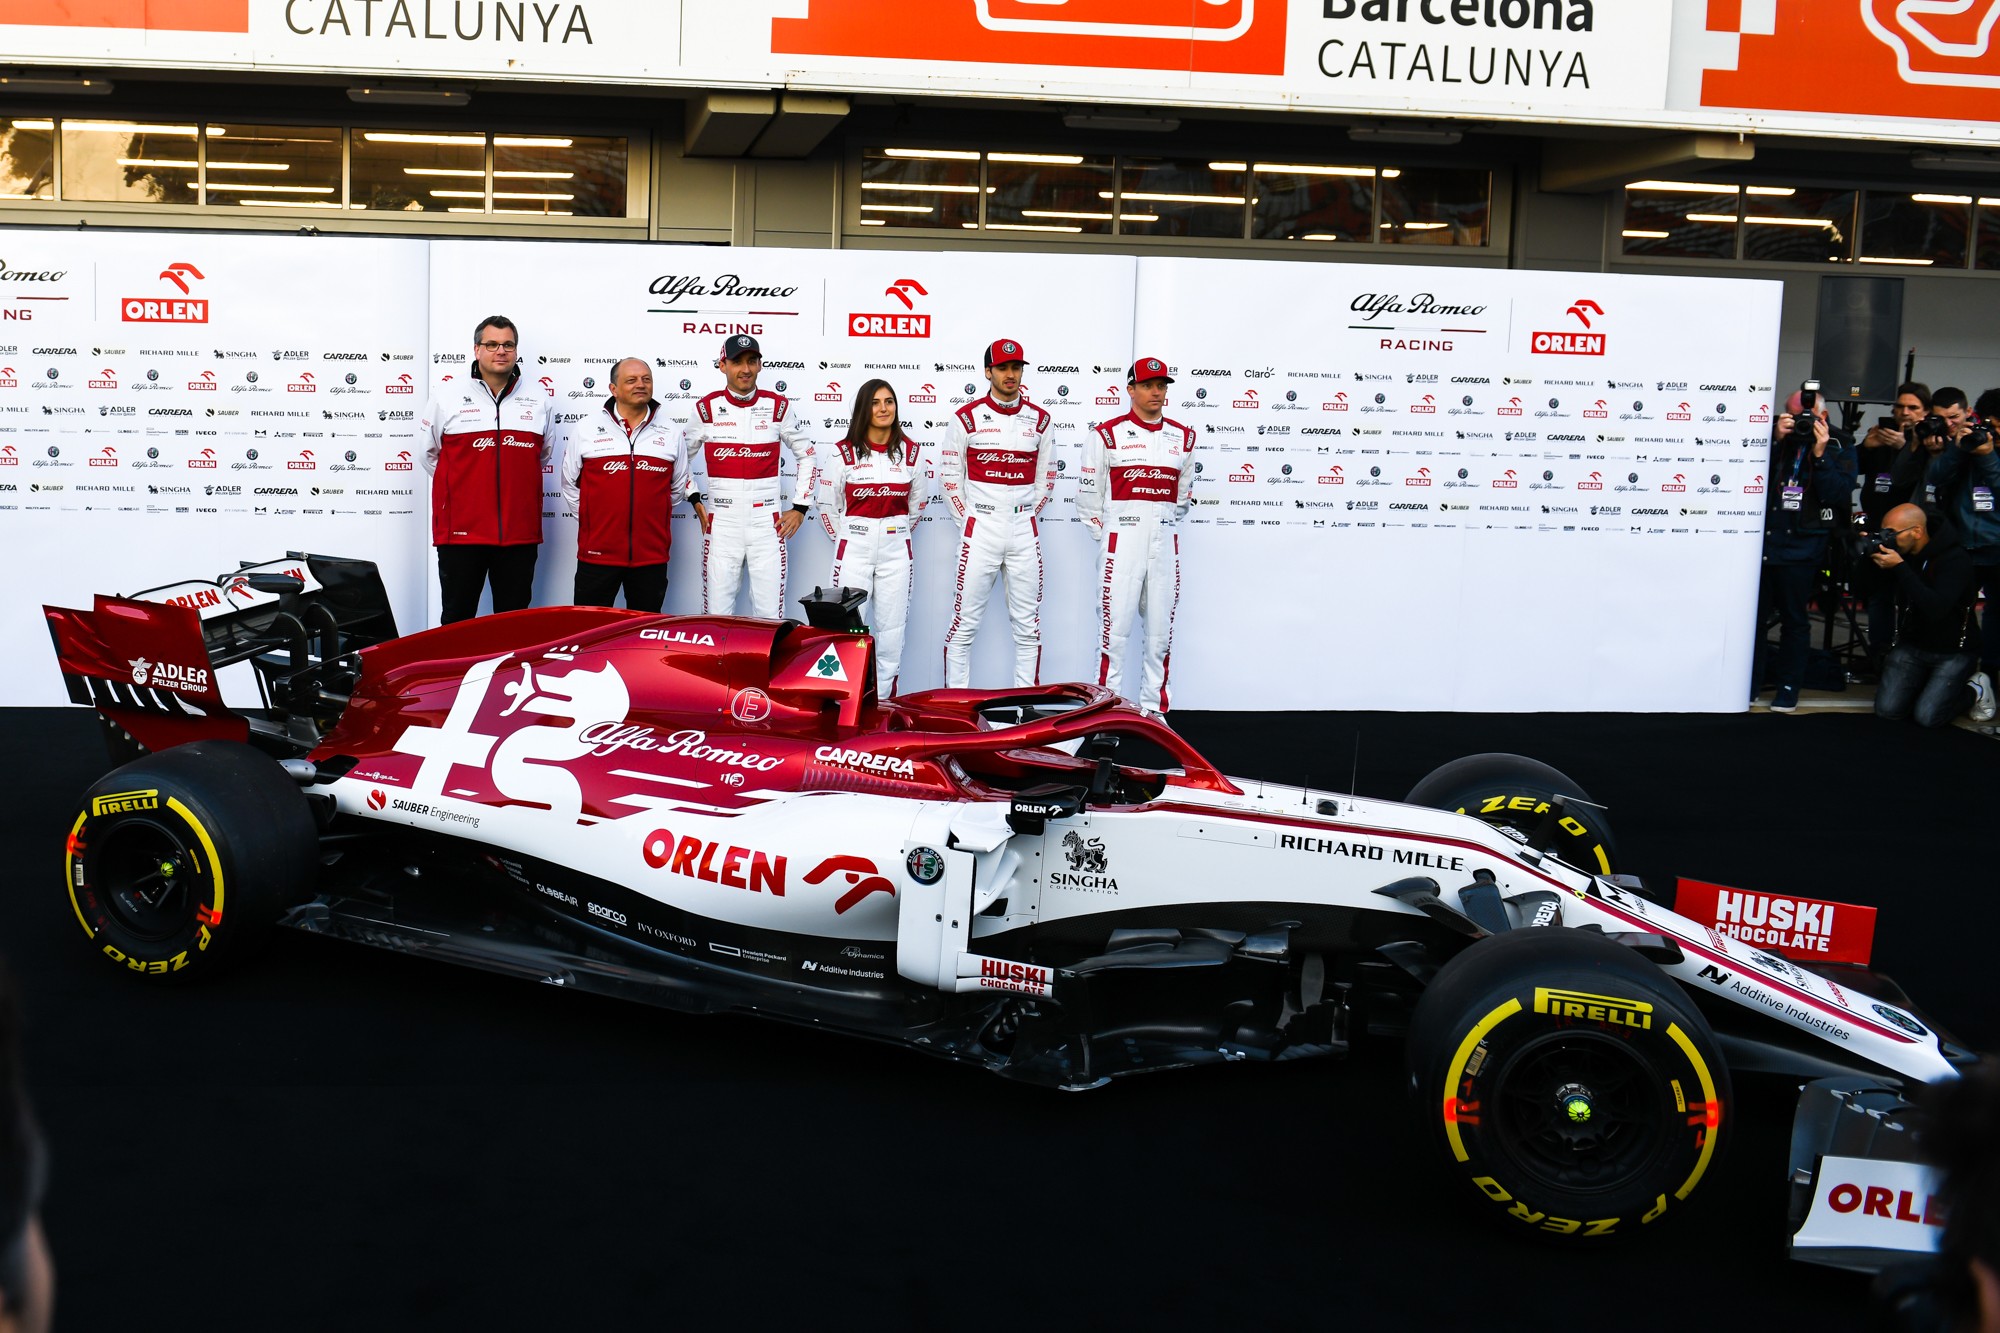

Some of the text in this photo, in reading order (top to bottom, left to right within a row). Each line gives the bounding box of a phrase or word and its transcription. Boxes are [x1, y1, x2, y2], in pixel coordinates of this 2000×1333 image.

[285, 0, 593, 44] CATALUNYA
[1323, 0, 1593, 32] Barcelona
[1318, 39, 1590, 89] CATALUNYA
[649, 274, 798, 304] Alfa Romeo
[126, 301, 203, 321] ORLEN
[1350, 293, 1487, 321] Alfa Romeo
[683, 323, 763, 335] RACING
[852, 316, 926, 335] ORLEN
[32, 347, 77, 355] CARRERA
[1380, 339, 1453, 351] RACING
[1534, 334, 1602, 353] ORLEN
[225, 351, 257, 359] SINGHA
[283, 350, 310, 358] ADLER
[323, 353, 368, 361] CARRERA
[762, 361, 805, 369] CARRERA
[1037, 365, 1080, 373] CARRERA
[1191, 368, 1232, 377] CARRERA
[1244, 369, 1271, 379] Claro
[1365, 373, 1393, 381] SINGHA
[1451, 376, 1490, 384] CARRERA
[1700, 384, 1737, 392] CARRERA
[910, 395, 935, 403] ORLEN
[1096, 397, 1119, 405] ORLEN
[1323, 403, 1347, 411] ORLEN
[54, 407, 85, 415] SINGHA
[148, 408, 193, 417] CARRERA
[472, 435, 535, 451] Alfa Romeo
[1547, 434, 1586, 442] CARRERA
[713, 447, 772, 461] Alfa Romeo
[976, 452, 1000, 464] Alfa
[189, 460, 216, 468] ORLEN
[603, 460, 668, 474] Alfa Romeo
[985, 470, 1025, 479] GIULIA
[1123, 469, 1177, 482] Alfa Romeo
[159, 486, 191, 494] SINGHA
[254, 488, 298, 496] CARRERA
[852, 486, 908, 500] Alfa Romeo
[1132, 487, 1171, 495] STELVIO
[1631, 508, 1668, 516] CARRERA
[956, 541, 971, 591] ANTONIO
[1102, 557, 1114, 650] KIMI RÄIKKÖNEN
[639, 628, 715, 647] GIULIA
[152, 662, 208, 685] ADLER
[152, 677, 208, 693] PELZER GROUP
[579, 720, 784, 773] Alfa Romeo
[813, 759, 855, 771] EYEWEAR
[860, 767, 887, 777] SINCE
[814, 745, 914, 776] CARRERA
[92, 789, 158, 817] PIRELLI
[1014, 804, 1046, 814] ORLEN
[392, 799, 480, 828] SAUBER Engineering
[907, 848, 945, 870] ALFA ROMEO
[1280, 834, 1464, 872] RICHARD MILLE
[642, 828, 787, 898] ORLEN
[1050, 872, 1119, 891] SINGHA
[1049, 885, 1119, 896] CORPORATION
[587, 901, 627, 927] sparco
[1716, 890, 1835, 936] HUSKI
[637, 922, 697, 947] IVY OXFORD
[1714, 922, 1831, 953] CHOCOLATE
[103, 944, 190, 975] ZERO
[819, 964, 884, 979] Additive Industries
[981, 958, 1046, 988] HUSKI
[980, 978, 1045, 996] CHOCOLATE
[1533, 987, 1654, 1030] PIRELLI
[1730, 980, 1850, 1040] Additive Industries
[1472, 1176, 1667, 1236] P ZERO
[1828, 1183, 1947, 1227] ORLE
